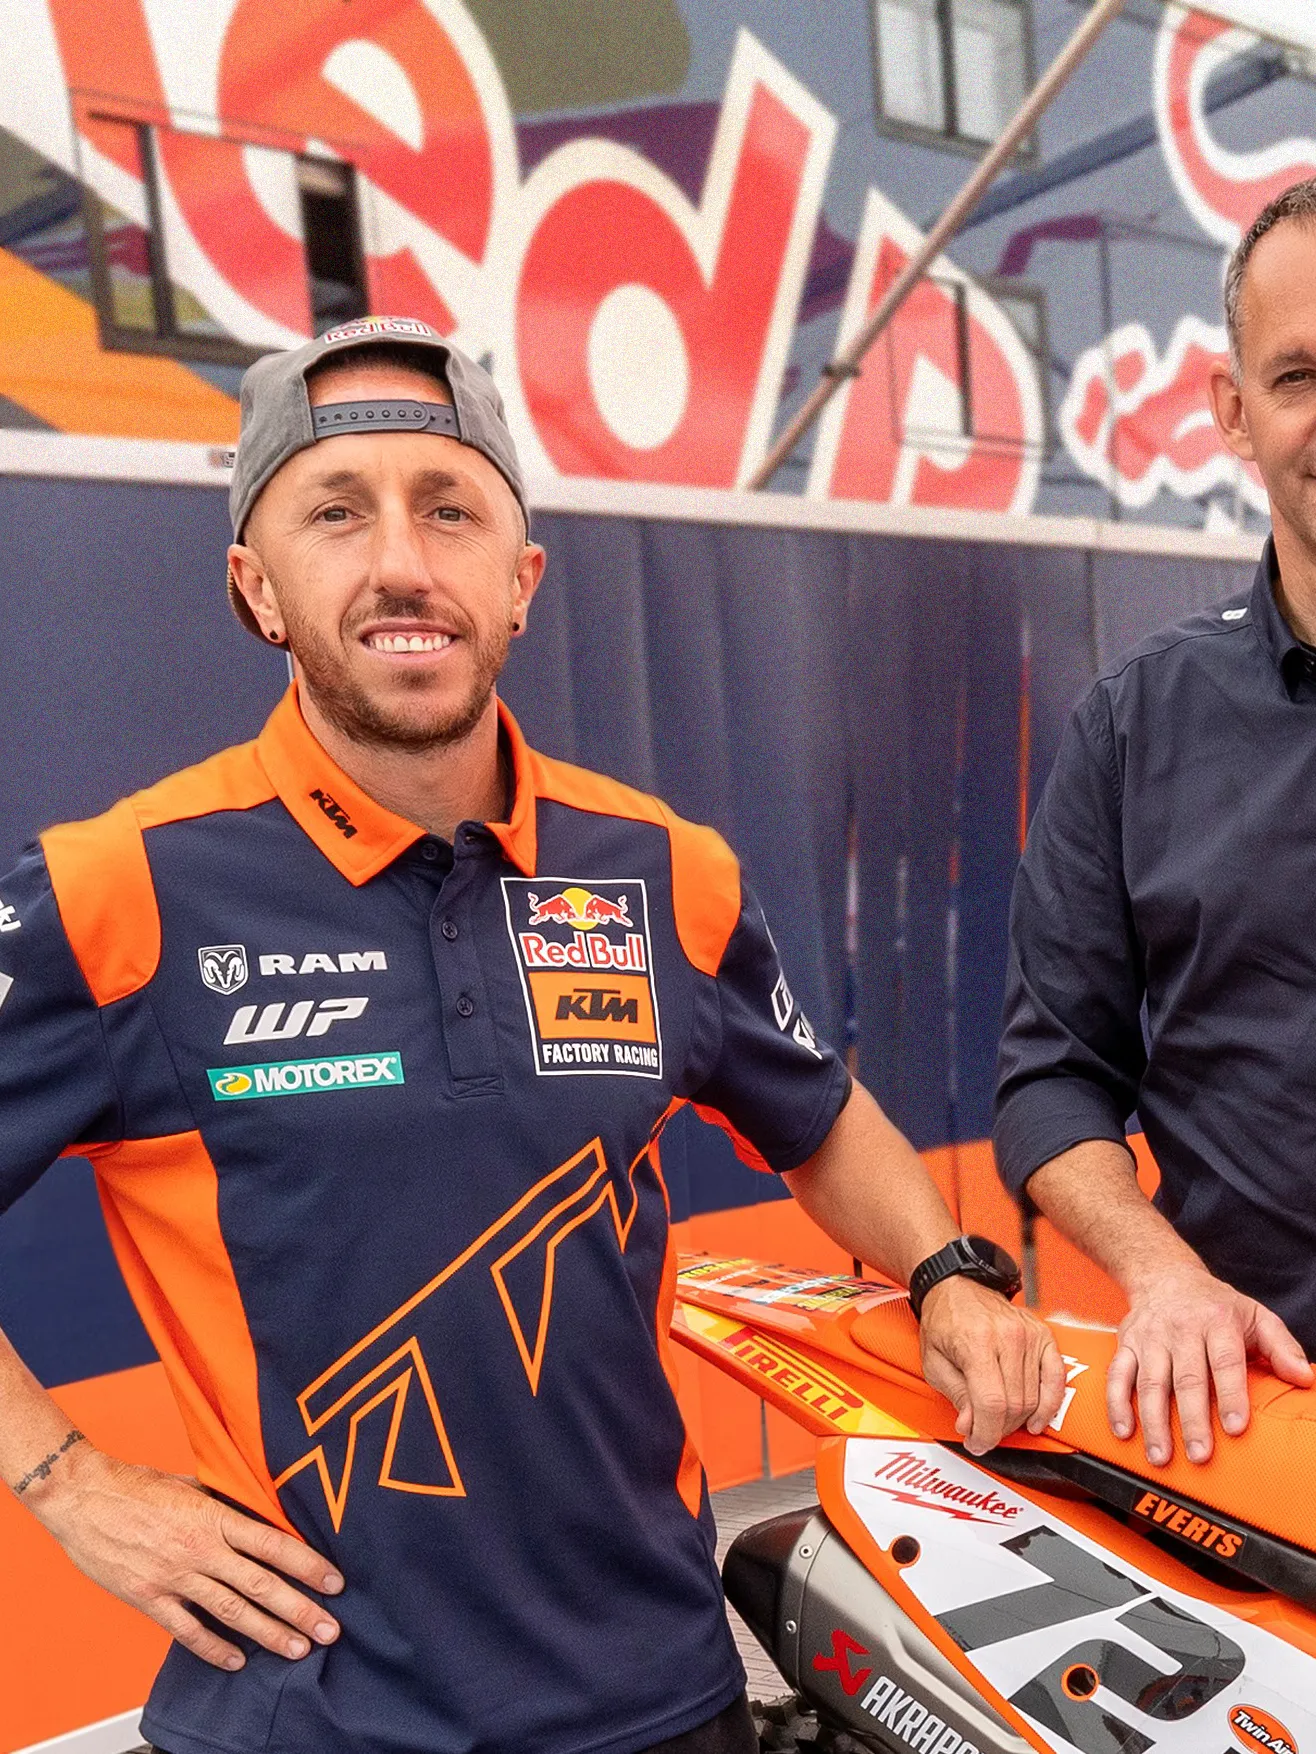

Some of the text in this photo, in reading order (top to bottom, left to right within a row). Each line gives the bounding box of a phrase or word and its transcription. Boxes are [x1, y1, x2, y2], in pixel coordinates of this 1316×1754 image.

[325, 322, 377, 342] Red
[309, 789, 357, 839] KTM
[259, 951, 388, 976] RAM
[522, 933, 645, 970] Red Bull
[223, 997, 369, 1045] WP
[555, 988, 639, 1024] KTM
[542, 1043, 659, 1068] FACTORY RACING
[254, 1057, 395, 1093] MOTOREX
[720, 1327, 864, 1421] PIRELLI
[874, 1451, 1019, 1519] Milwaukee
[1133, 1493, 1244, 1559] EVERTS
[932, 1525, 1246, 1754] 72
[1233, 1710, 1271, 1743] Twin
